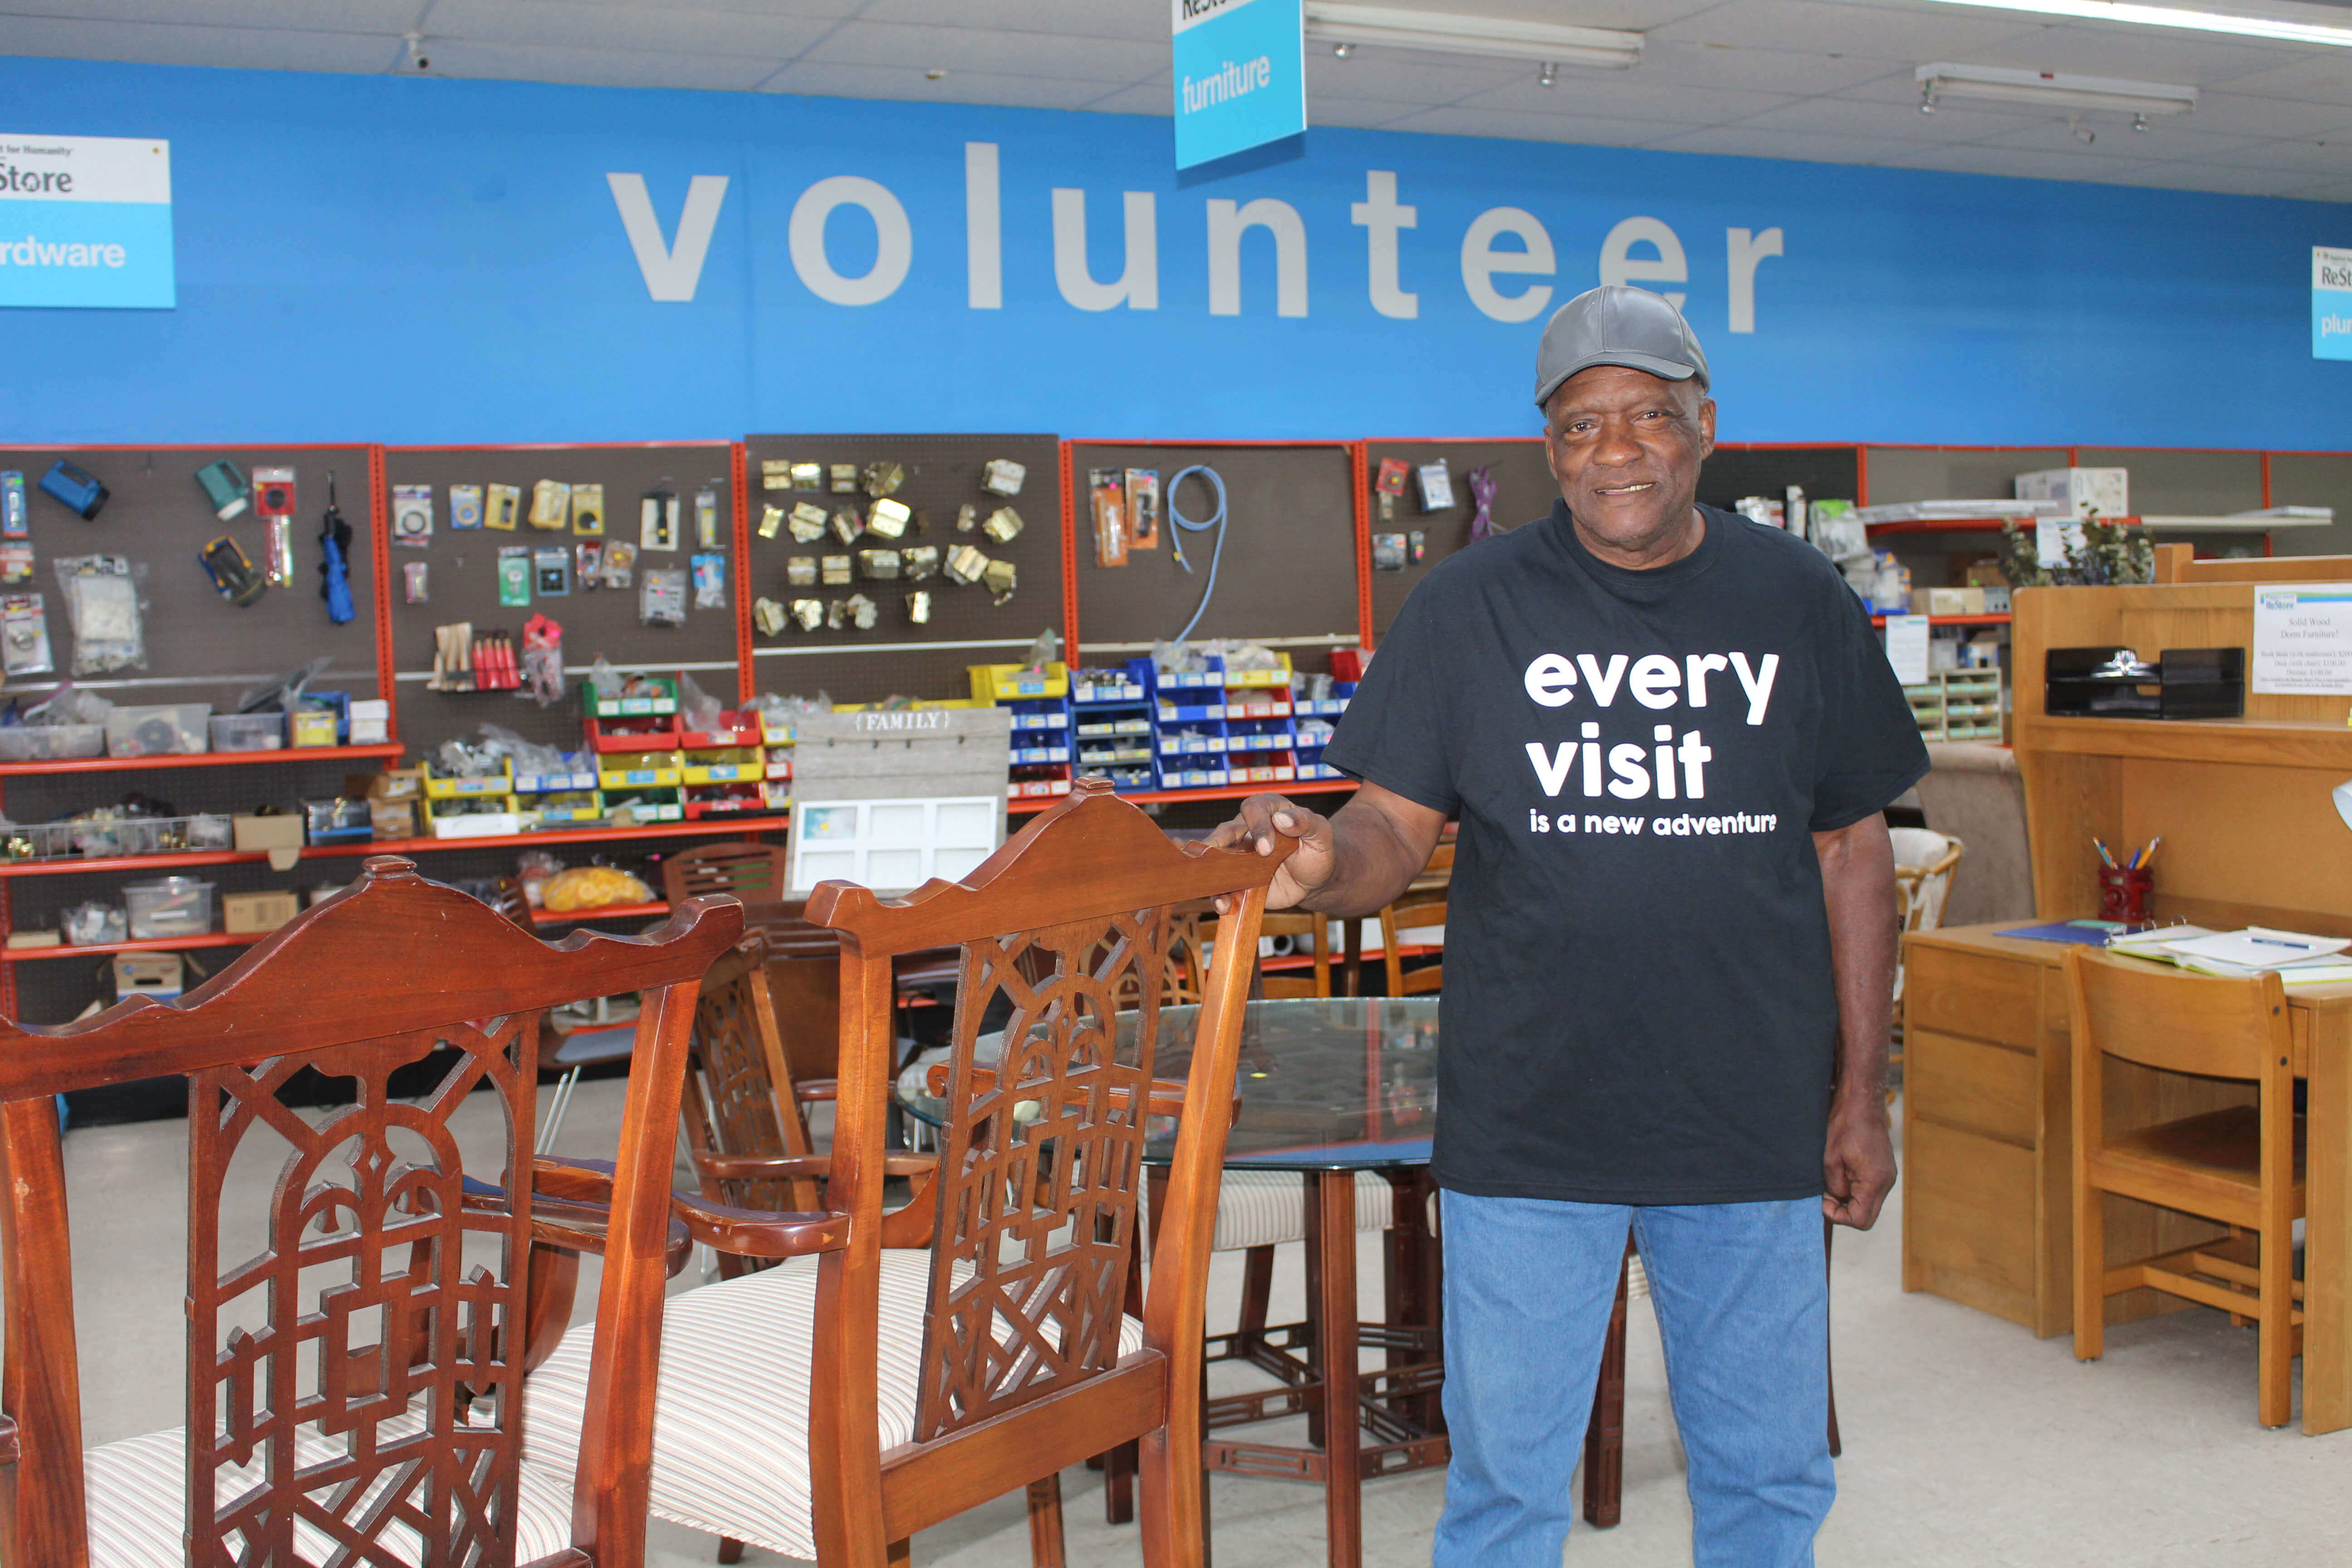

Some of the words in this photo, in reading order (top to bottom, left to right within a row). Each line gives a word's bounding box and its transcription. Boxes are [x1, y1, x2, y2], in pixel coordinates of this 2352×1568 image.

[1182, 55, 1270, 114] furniture
[23, 145, 71, 157] Humanity
[607, 142, 1783, 333] volunteer
[2281, 630, 2301, 639] Dorm
[2289, 617, 2307, 626] Solid
[2309, 617, 2330, 626] Wood
[1524, 652, 1779, 725] every
[1525, 721, 1712, 800] visit
[1530, 808, 1550, 833] is
[1557, 814, 1576, 833] a
[1584, 814, 1645, 835] new
